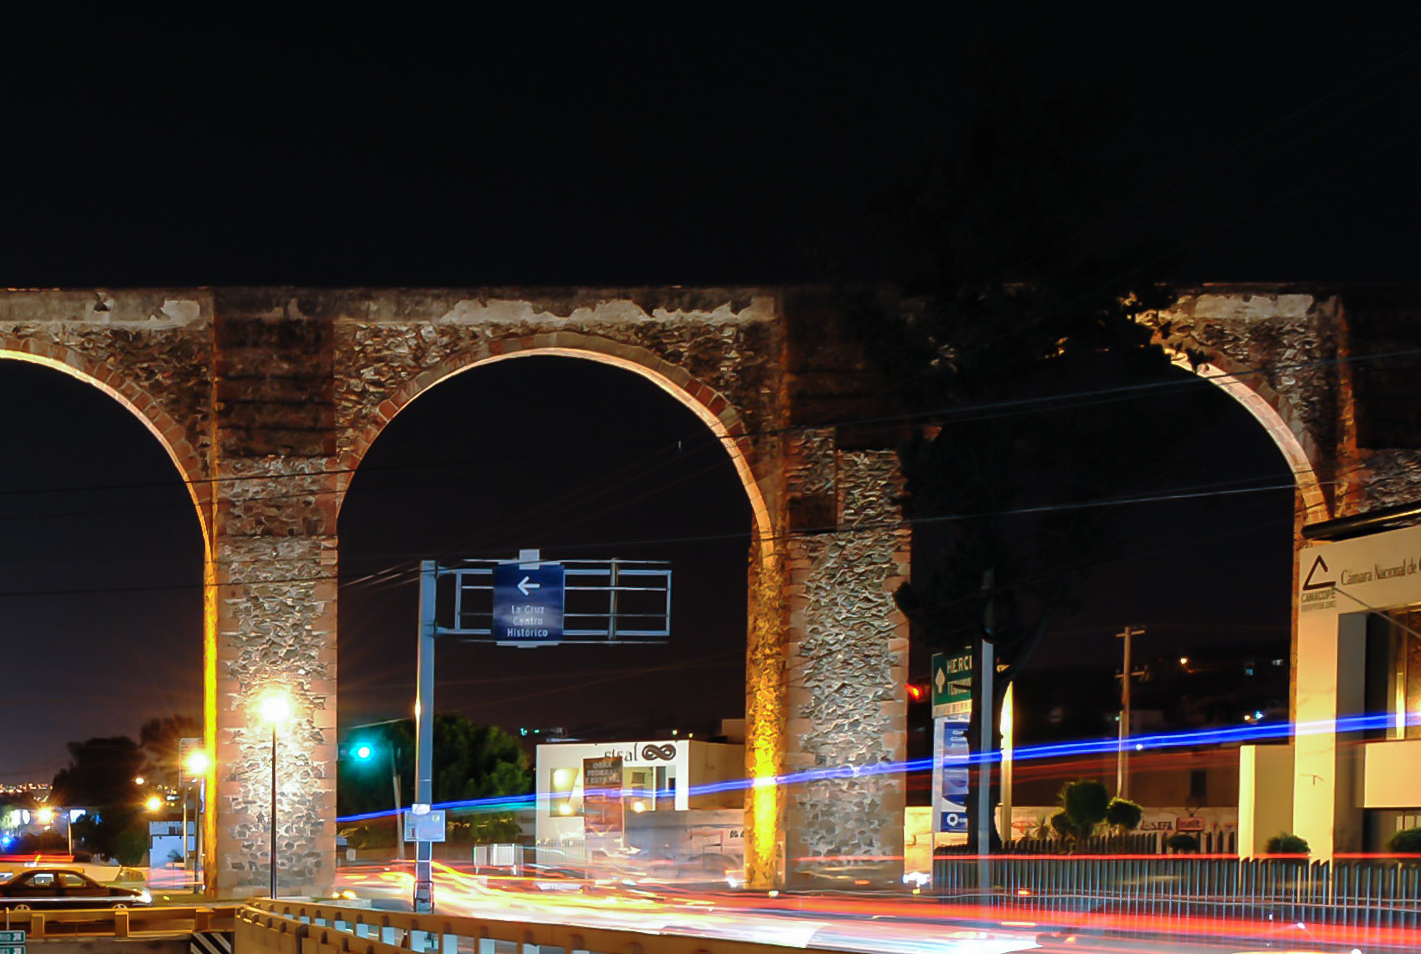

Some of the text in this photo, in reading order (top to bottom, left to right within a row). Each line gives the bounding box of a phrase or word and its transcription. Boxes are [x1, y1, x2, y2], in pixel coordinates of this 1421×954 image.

[1407, 556, 1418, 575] de
[511, 605, 545, 614] La Cruz
[513, 616, 543, 626] Centro
